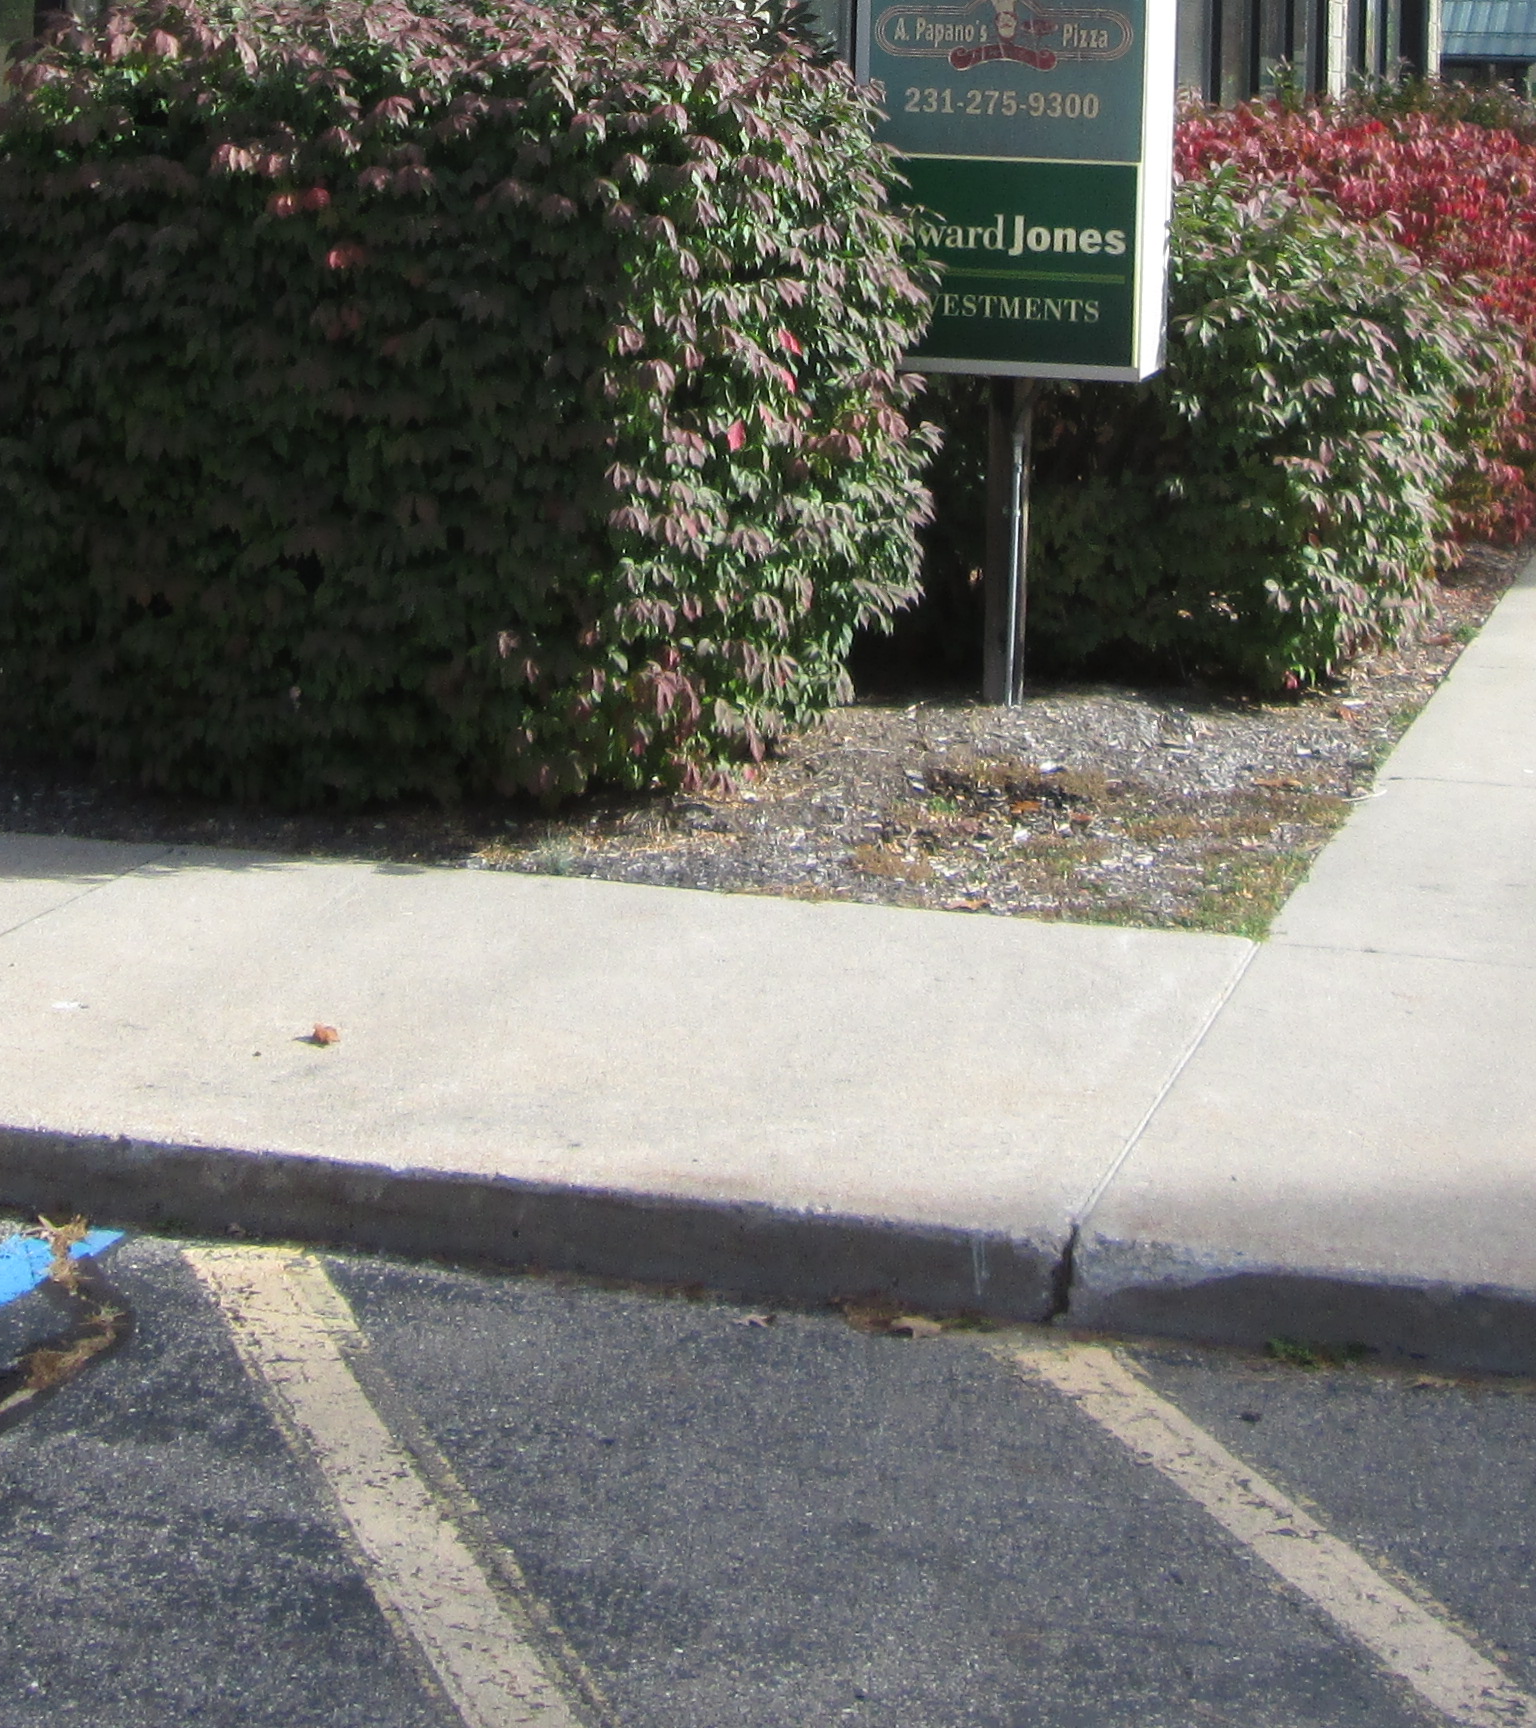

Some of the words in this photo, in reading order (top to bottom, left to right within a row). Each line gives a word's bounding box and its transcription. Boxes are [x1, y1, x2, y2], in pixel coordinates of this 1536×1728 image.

[894, 18, 910, 41] A.
[916, 17, 989, 47] Papano's
[1062, 24, 1109, 48] Pizza
[904, 87, 1101, 119] 231-275-9300
